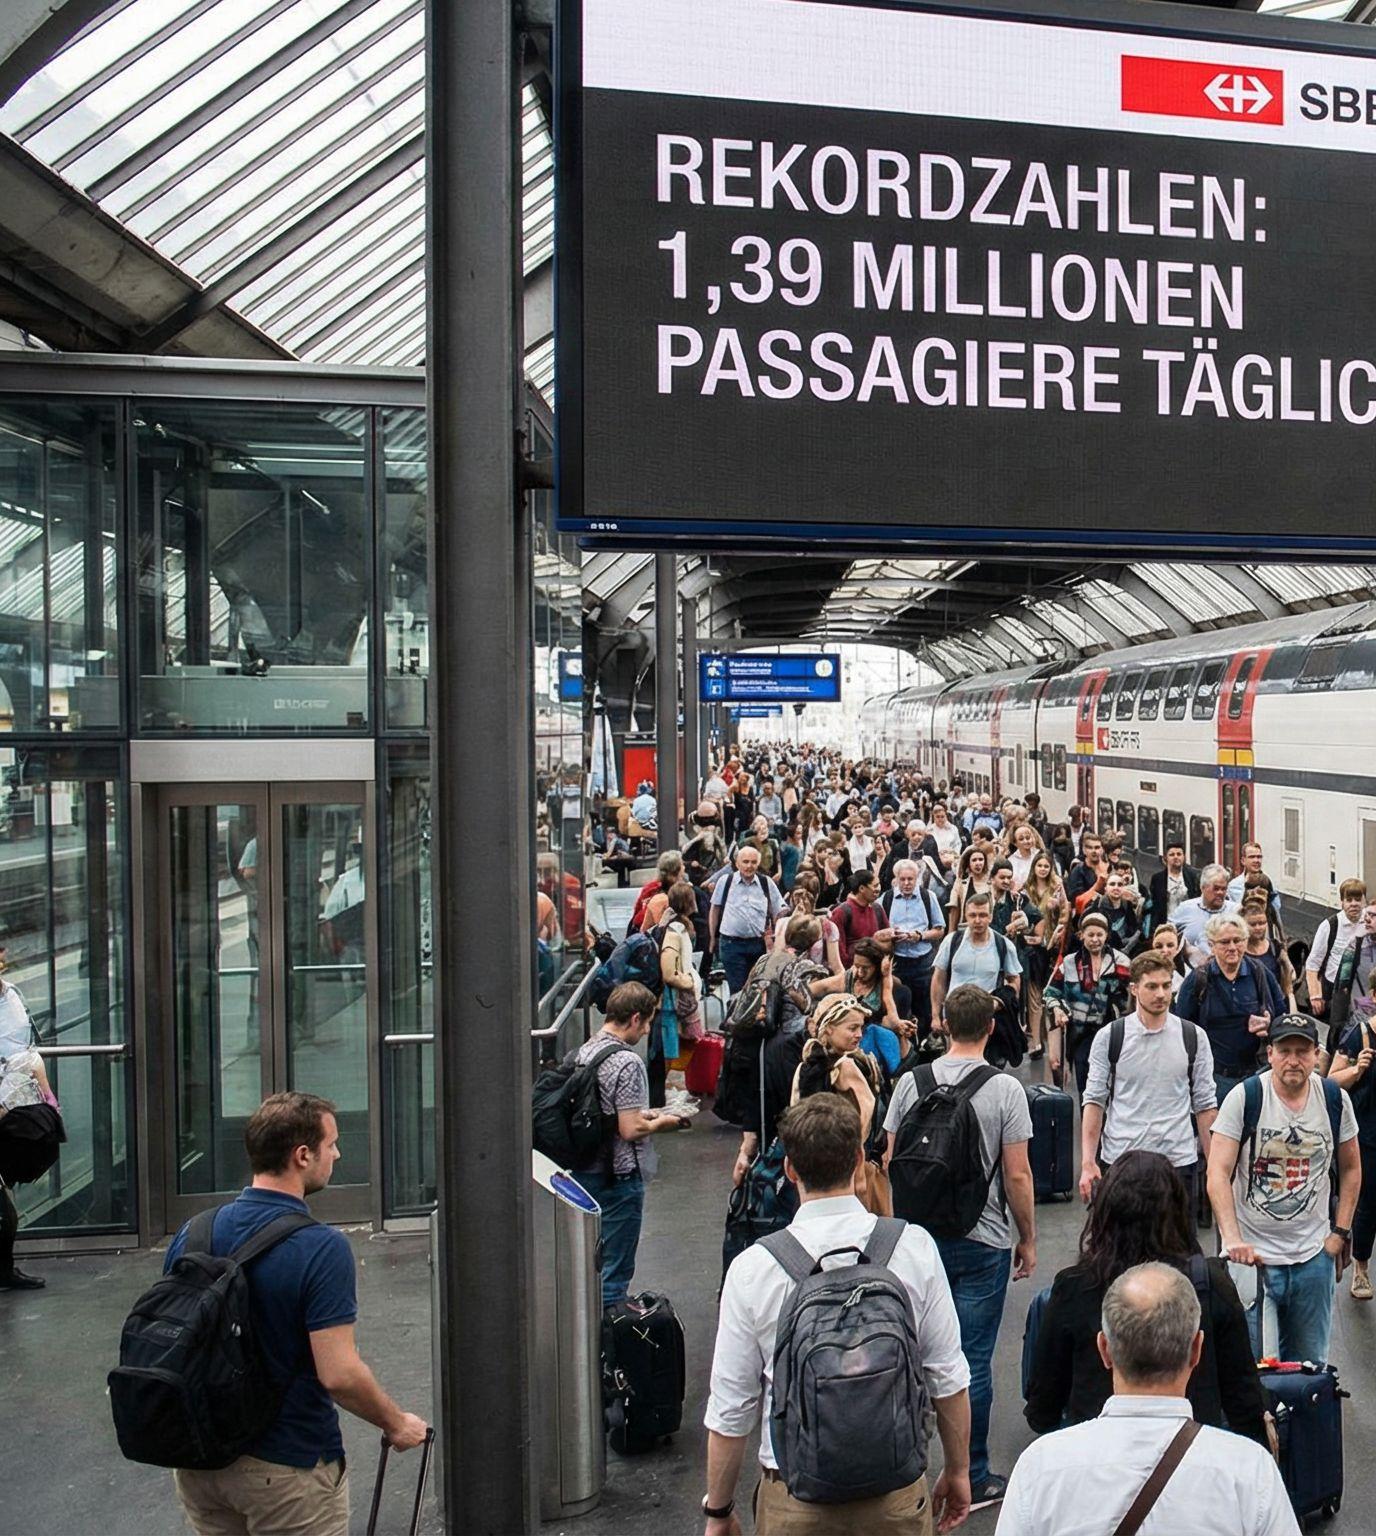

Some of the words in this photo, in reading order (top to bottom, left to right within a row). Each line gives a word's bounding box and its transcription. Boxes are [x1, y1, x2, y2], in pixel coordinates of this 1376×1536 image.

[657, 133, 1266, 243] REKORDZAHLEN:
[658, 230, 823, 315] 1,39
[852, 240, 1243, 330] MILLIONEN
[657, 324, 1121, 413] PASSAGIERE
